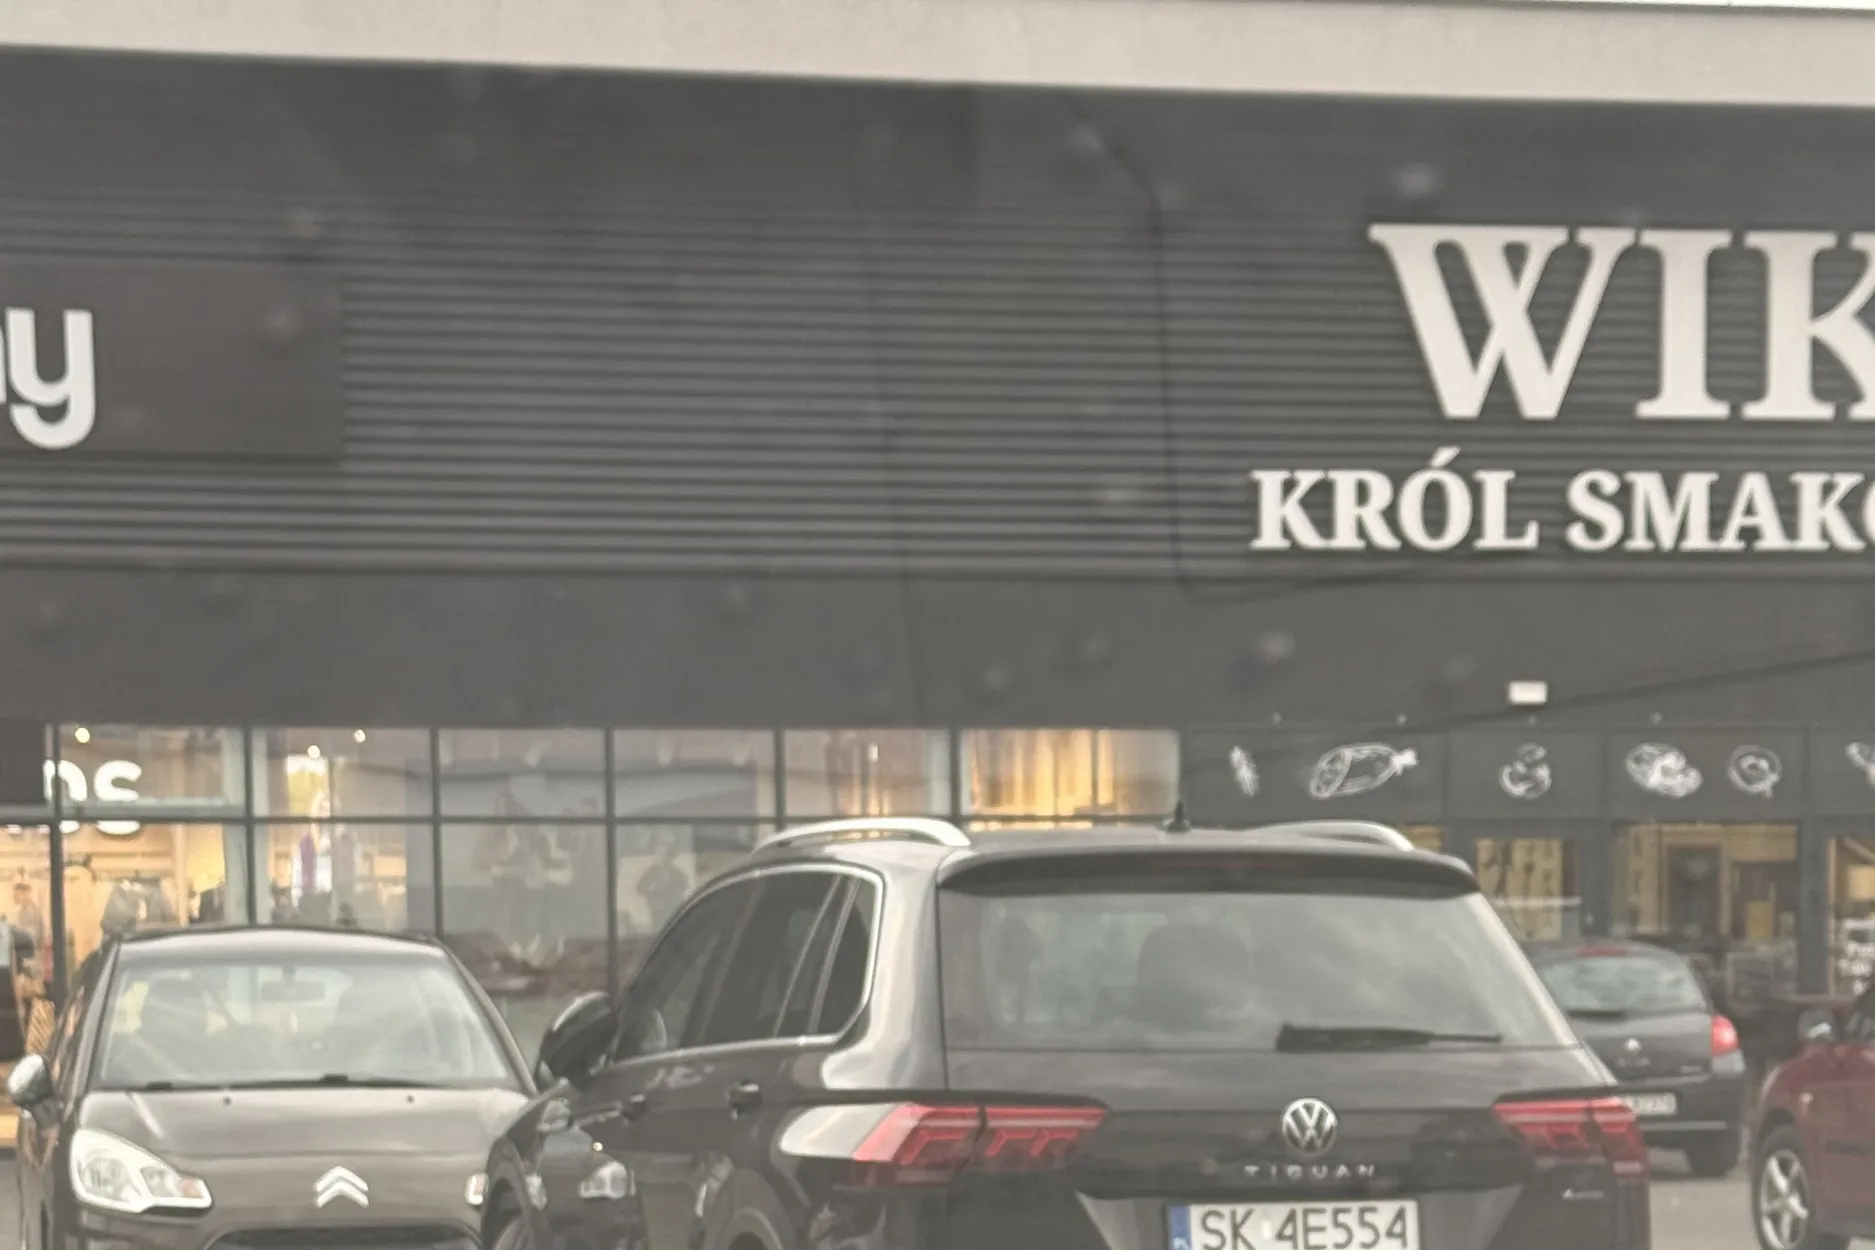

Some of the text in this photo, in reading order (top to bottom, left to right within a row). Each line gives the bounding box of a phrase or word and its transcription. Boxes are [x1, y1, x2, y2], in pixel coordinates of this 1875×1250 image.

[0, 307, 96, 450] y
[1368, 223, 1875, 420] WIK
[1249, 446, 1875, 552] KRÓL SMAK
[1275, 1205, 1409, 1250] 4E554
